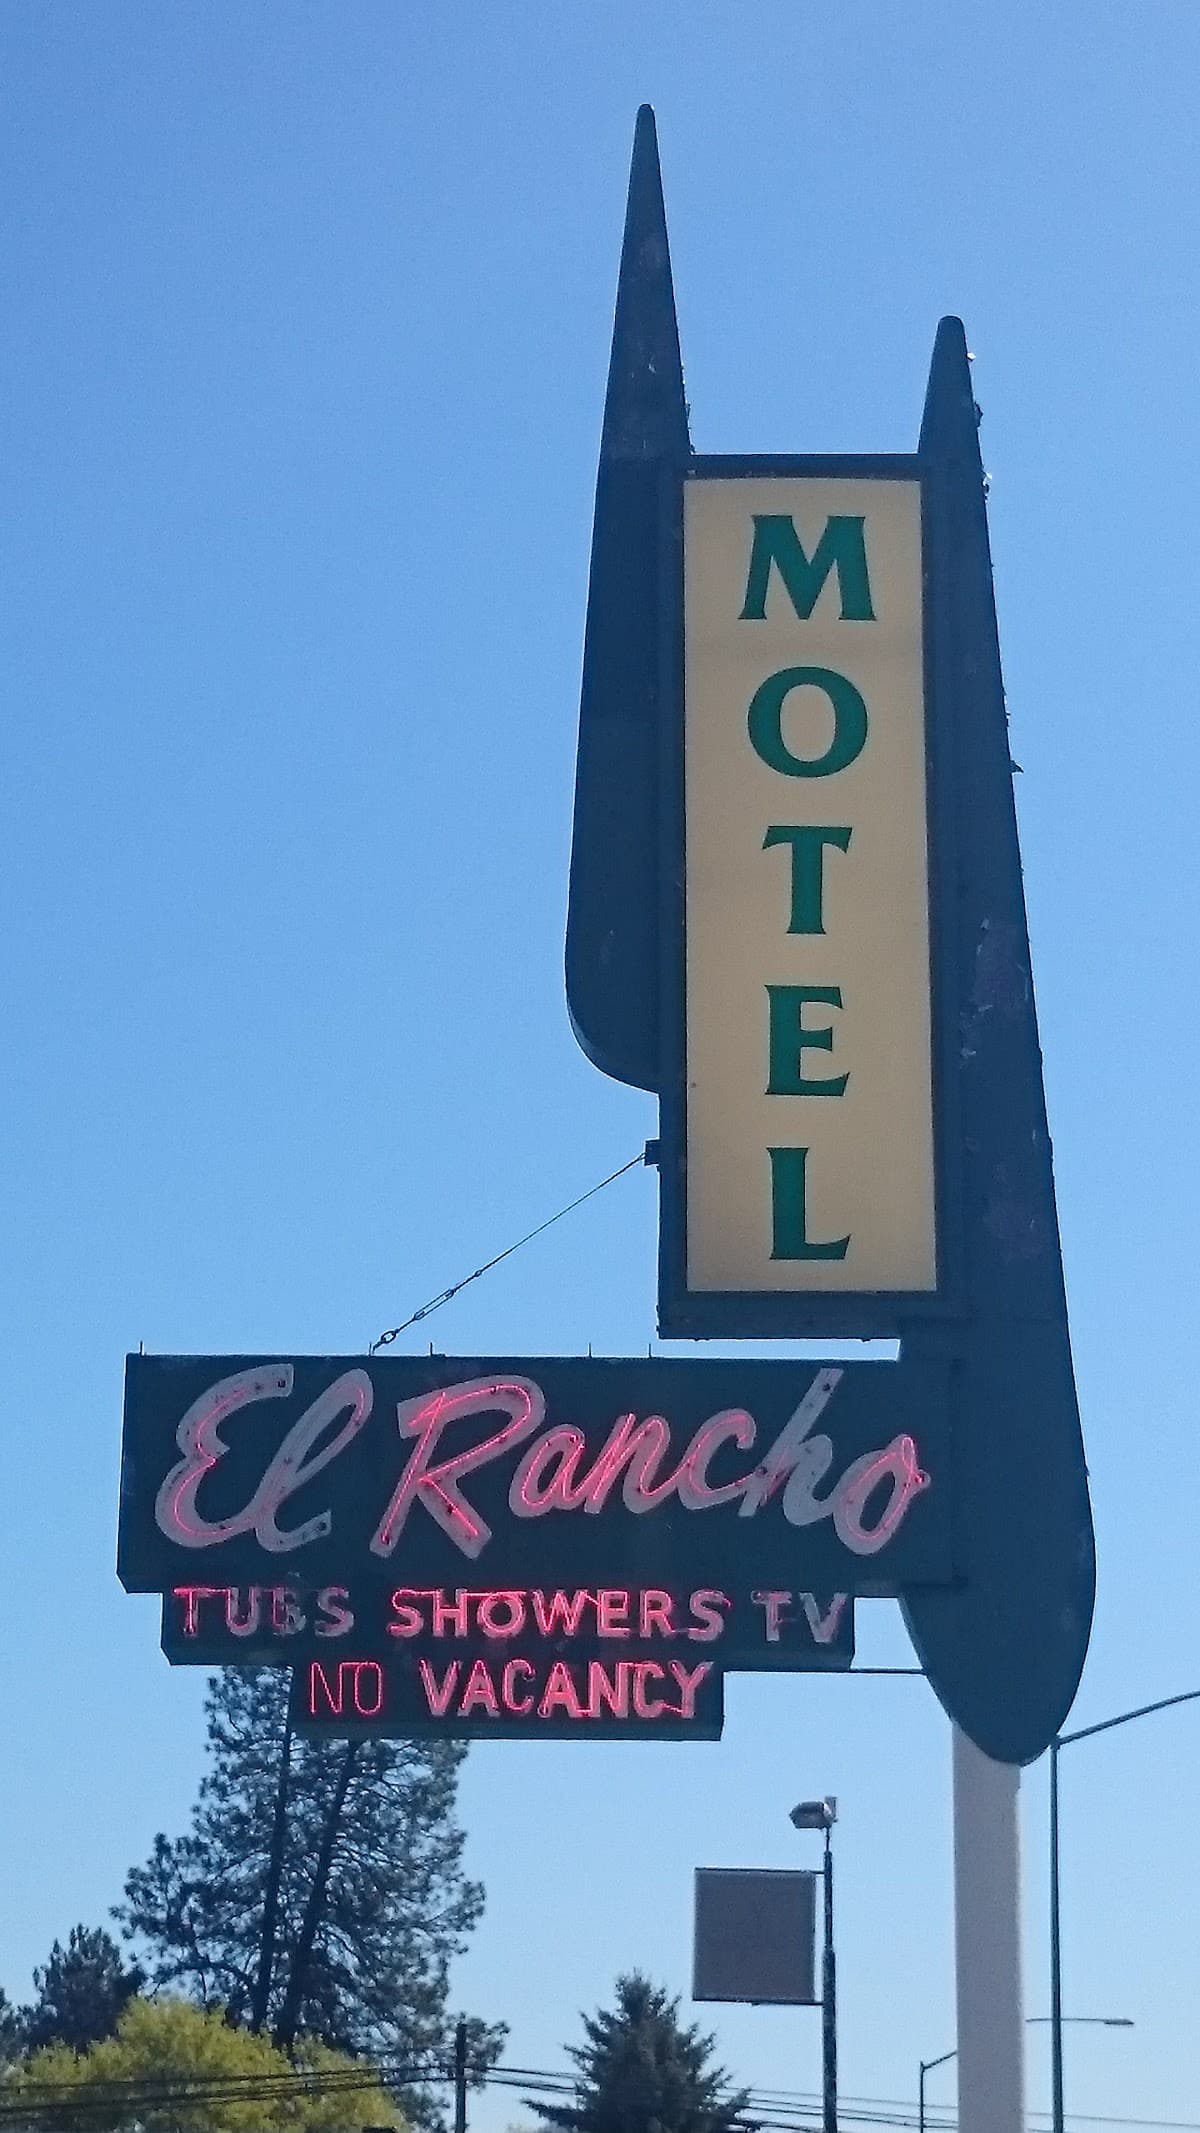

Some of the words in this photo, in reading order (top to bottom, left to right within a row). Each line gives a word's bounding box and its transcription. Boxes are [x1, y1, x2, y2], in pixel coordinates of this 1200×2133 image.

[738, 515, 877, 1260] MOTEL
[154, 1363, 373, 1552] El
[370, 1368, 932, 1559] Rancho
[173, 1586, 355, 1638] TUBS
[390, 1587, 732, 1639] SHOWERS
[751, 1589, 848, 1644] TV
[309, 1660, 384, 1716] NO
[419, 1659, 715, 1720] VACANCY
